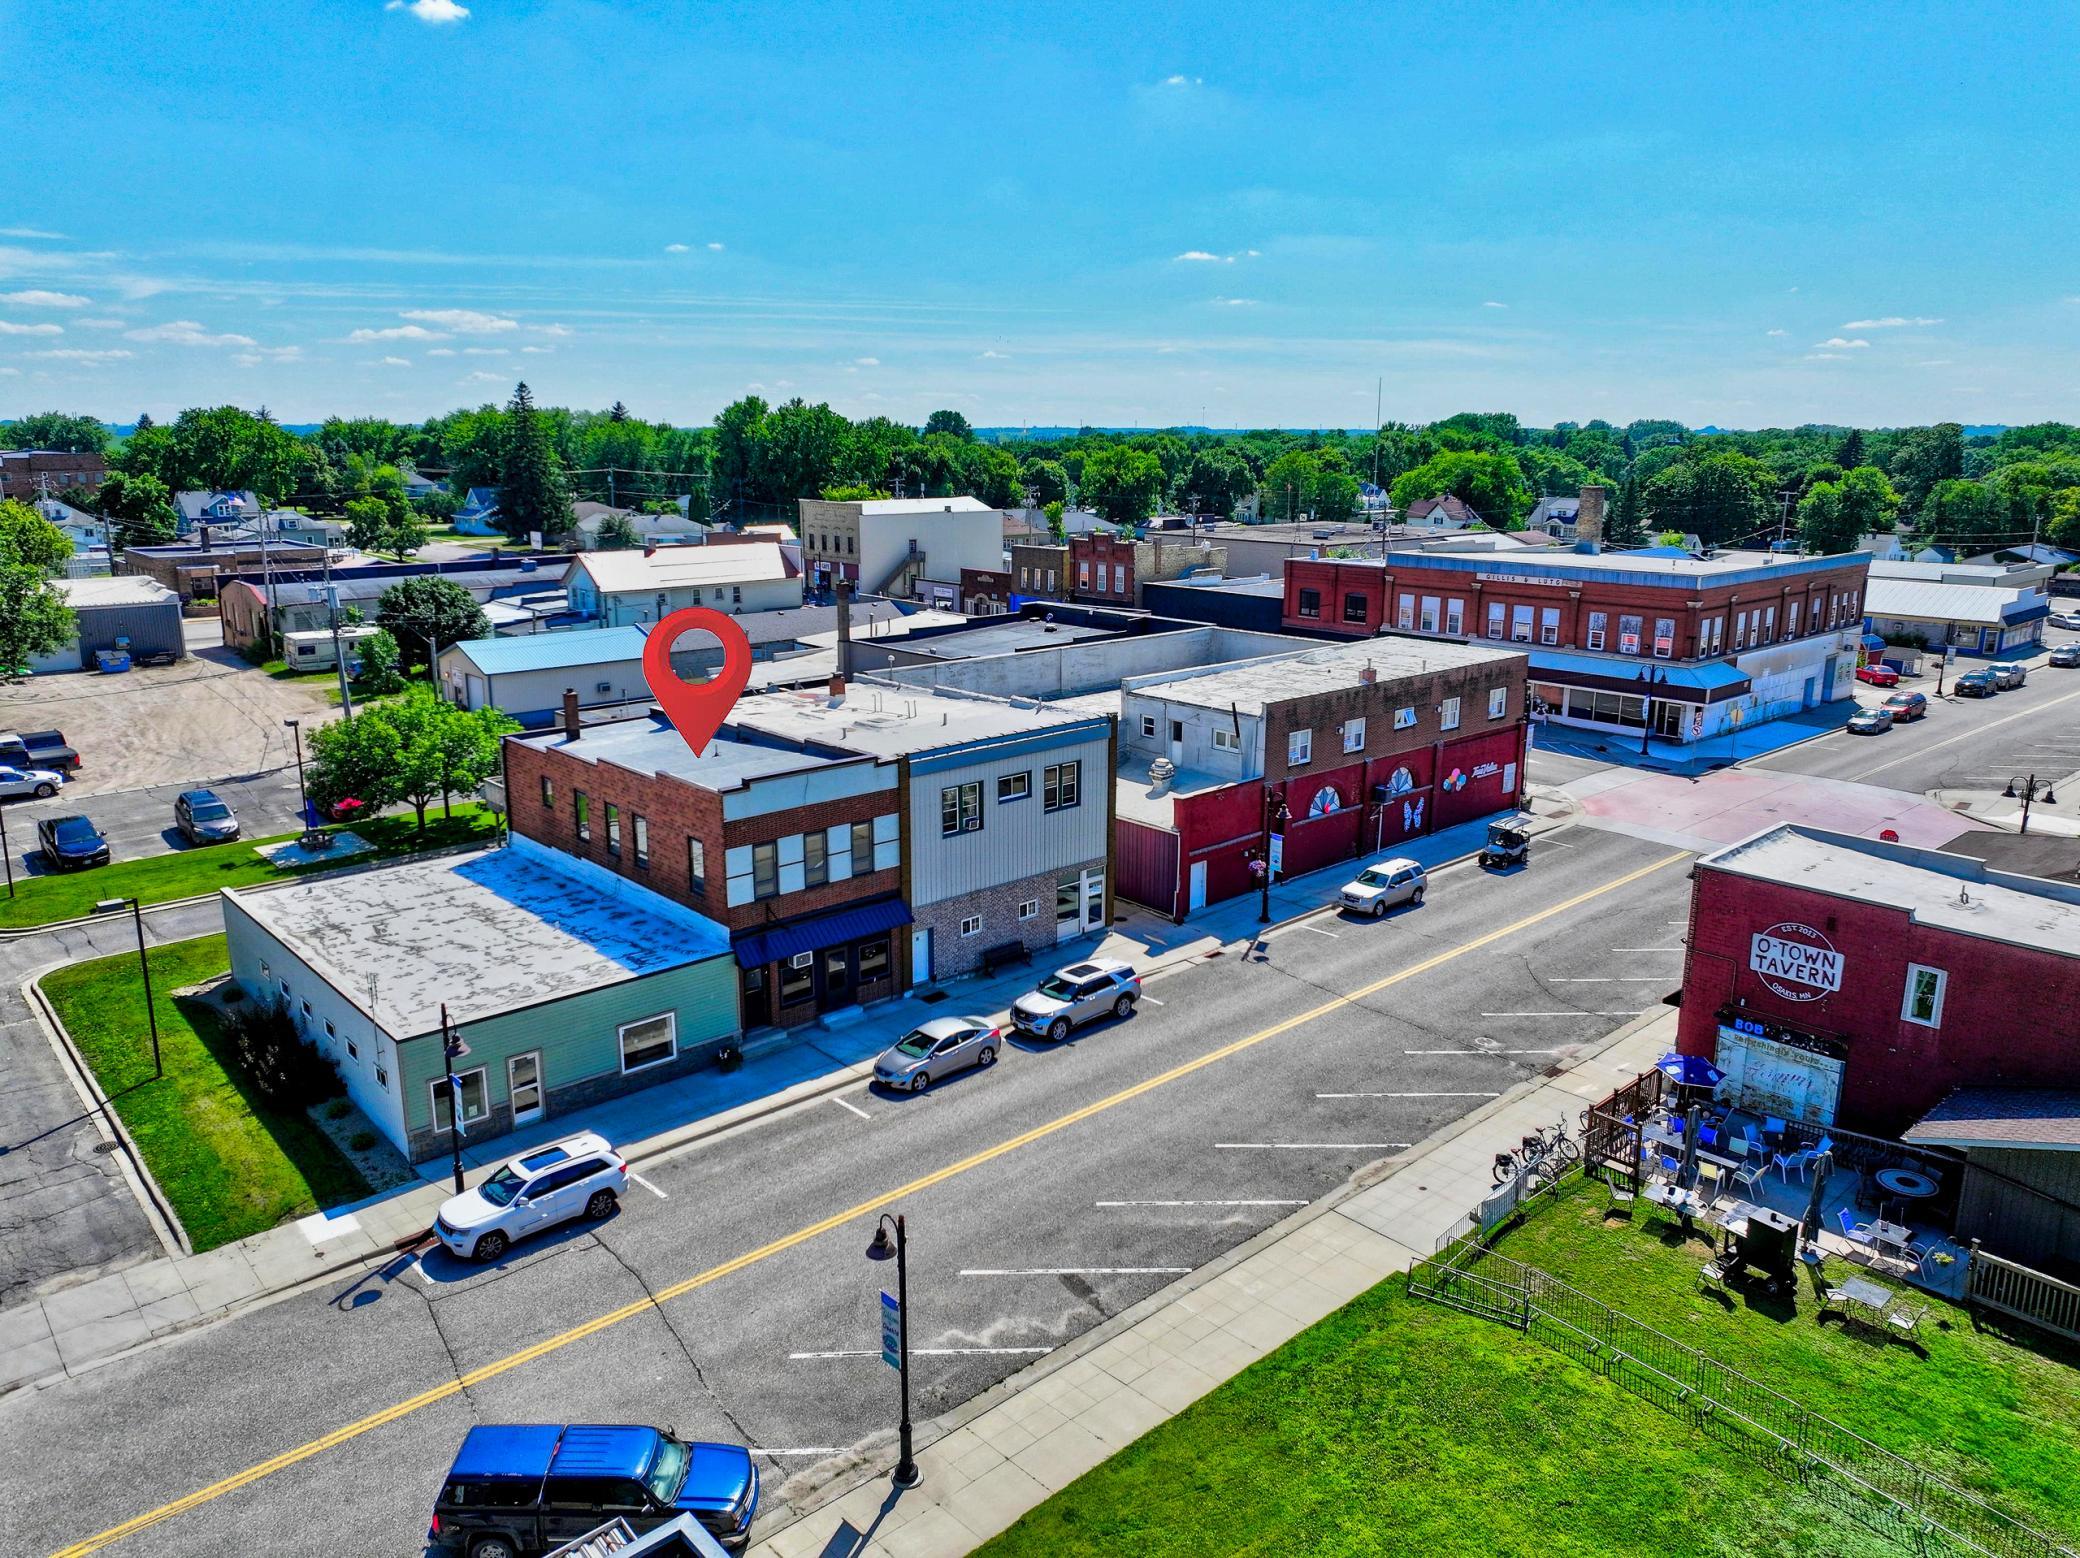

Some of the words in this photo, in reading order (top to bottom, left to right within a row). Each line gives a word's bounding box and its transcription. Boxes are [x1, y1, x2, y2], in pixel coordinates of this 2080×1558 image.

[1486, 574, 1515, 582] GILLIS
[1757, 937, 1836, 970] O-TOWN
[1755, 954, 1835, 987] TAVERN
[1772, 982, 1798, 1000] OSAKIS,
[1735, 1018, 1764, 1035] BOB
